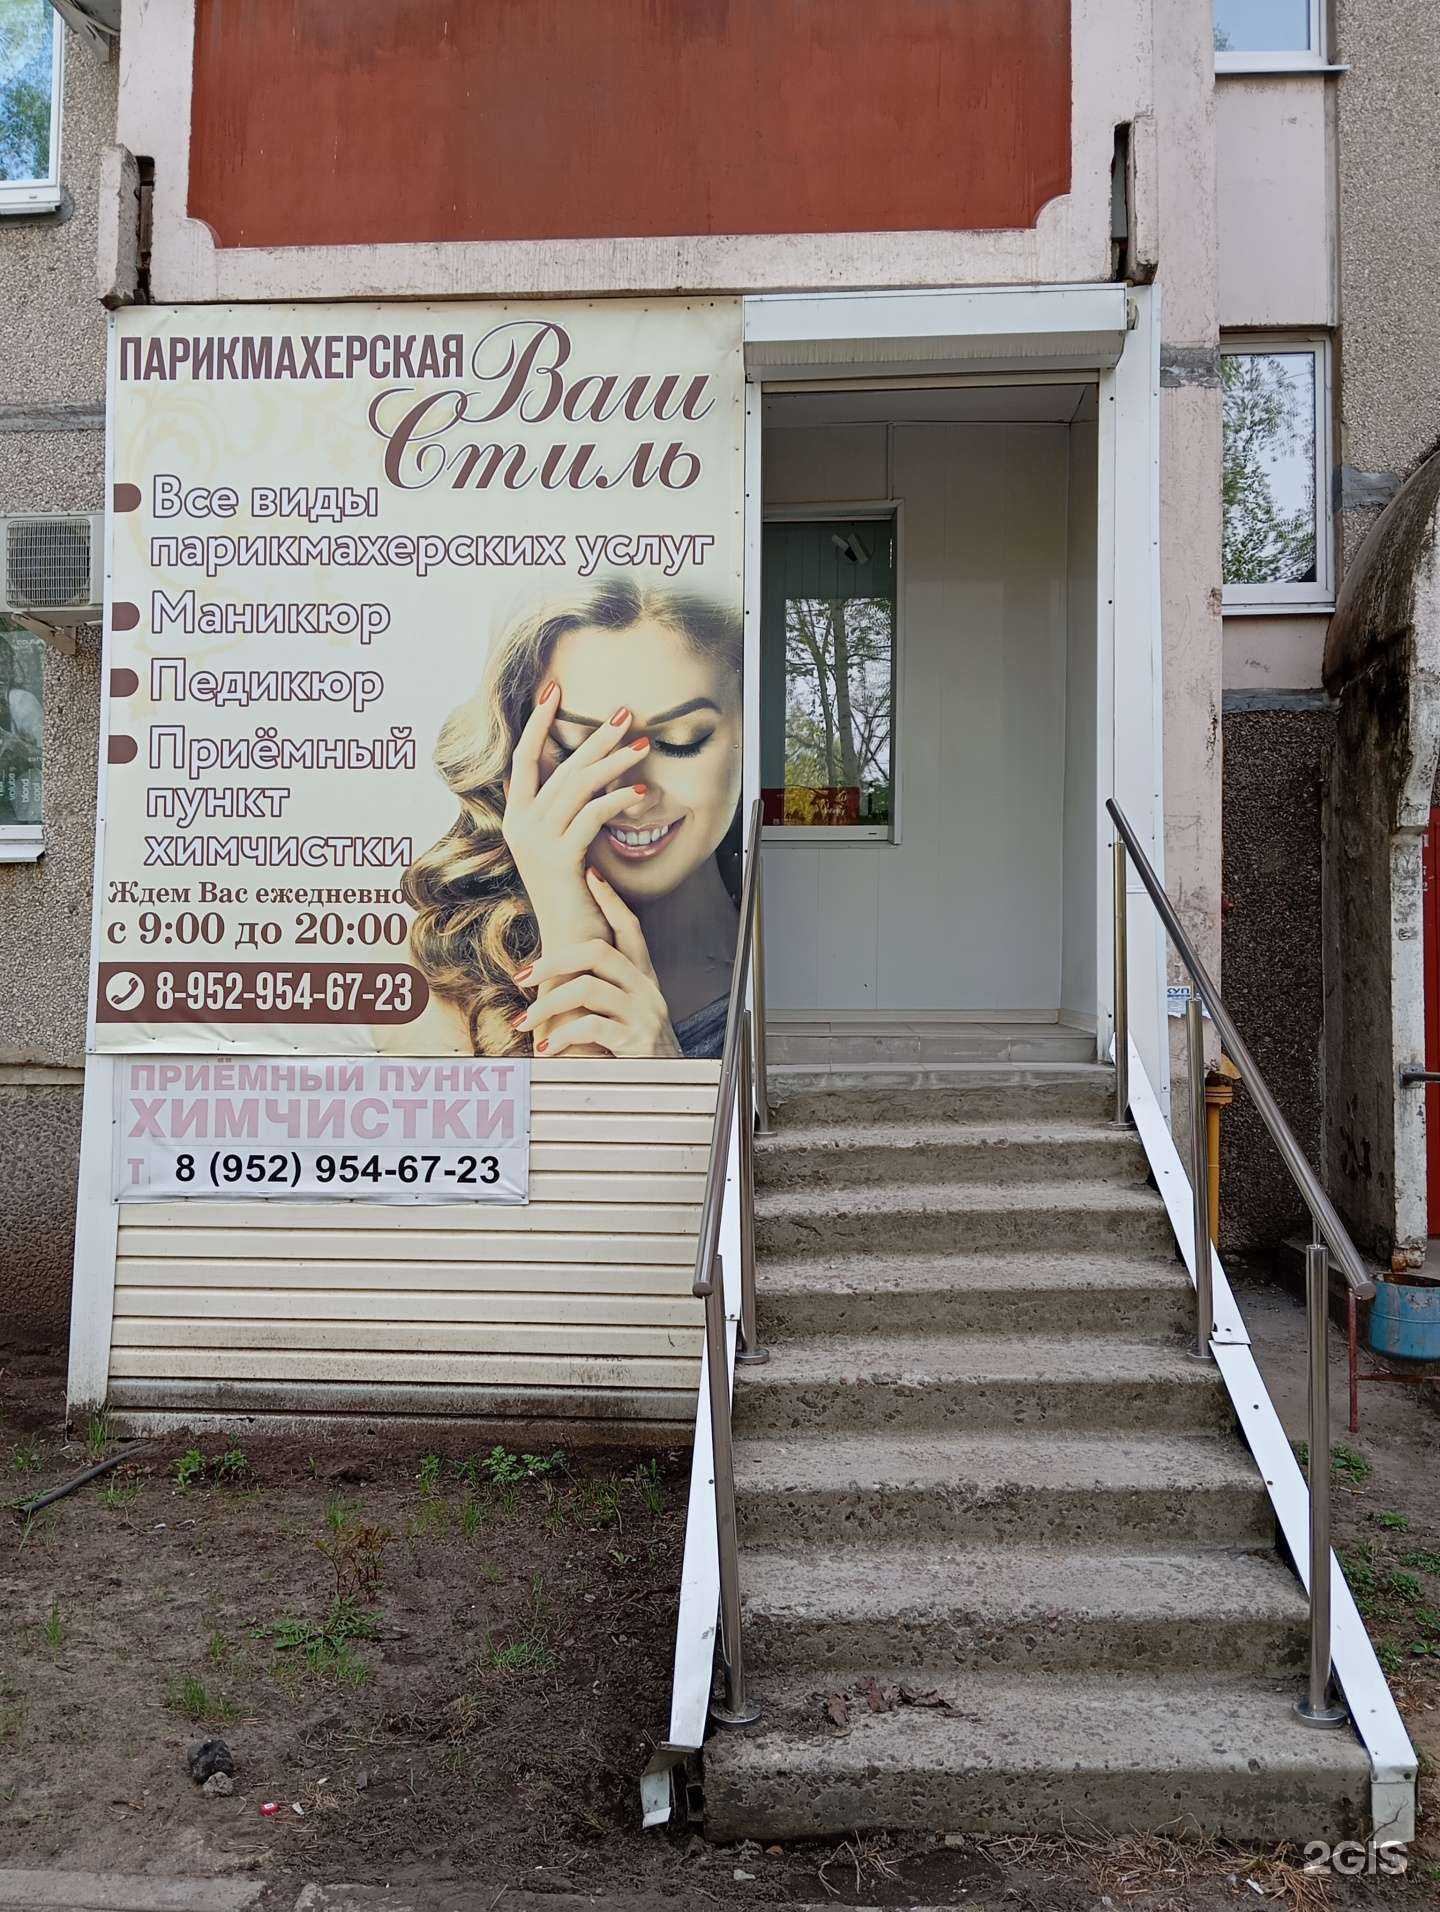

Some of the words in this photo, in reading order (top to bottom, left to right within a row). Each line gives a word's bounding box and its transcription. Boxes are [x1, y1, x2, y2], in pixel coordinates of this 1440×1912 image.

[120, 334, 464, 380] ПАРИКМАХЕРСКАЯ
[456, 321, 716, 423] Ваш
[368, 388, 702, 489] Стиль
[152, 474, 239, 518] Все
[251, 487, 379, 523] виды
[150, 535, 566, 577] парикмахерских
[575, 535, 715, 577] услуг
[151, 590, 391, 644] Маникюр
[150, 658, 384, 712] Педикюр
[149, 725, 416, 780] Приёмный
[146, 787, 290, 828] пункт
[143, 836, 413, 867] химчистки
[107, 881, 191, 906] Ждем
[199, 881, 248, 904] Вас
[255, 886, 406, 906] ежедневно
[107, 921, 127, 945] с
[138, 912, 225, 945] 9:00
[234, 921, 282, 950] до
[294, 912, 408, 945] 20:00
[156, 971, 413, 1011] 8-952-954-67-23
[129, 1057, 364, 1092] ПРИЁМНЫЙ
[378, 1065, 515, 1092] ПУНКТ
[128, 1097, 515, 1140] ХИМЧИСТКИ
[175, 1154, 195, 1182] 8
[209, 1151, 301, 1187] (952)
[315, 1154, 501, 1184] 954-67-23
